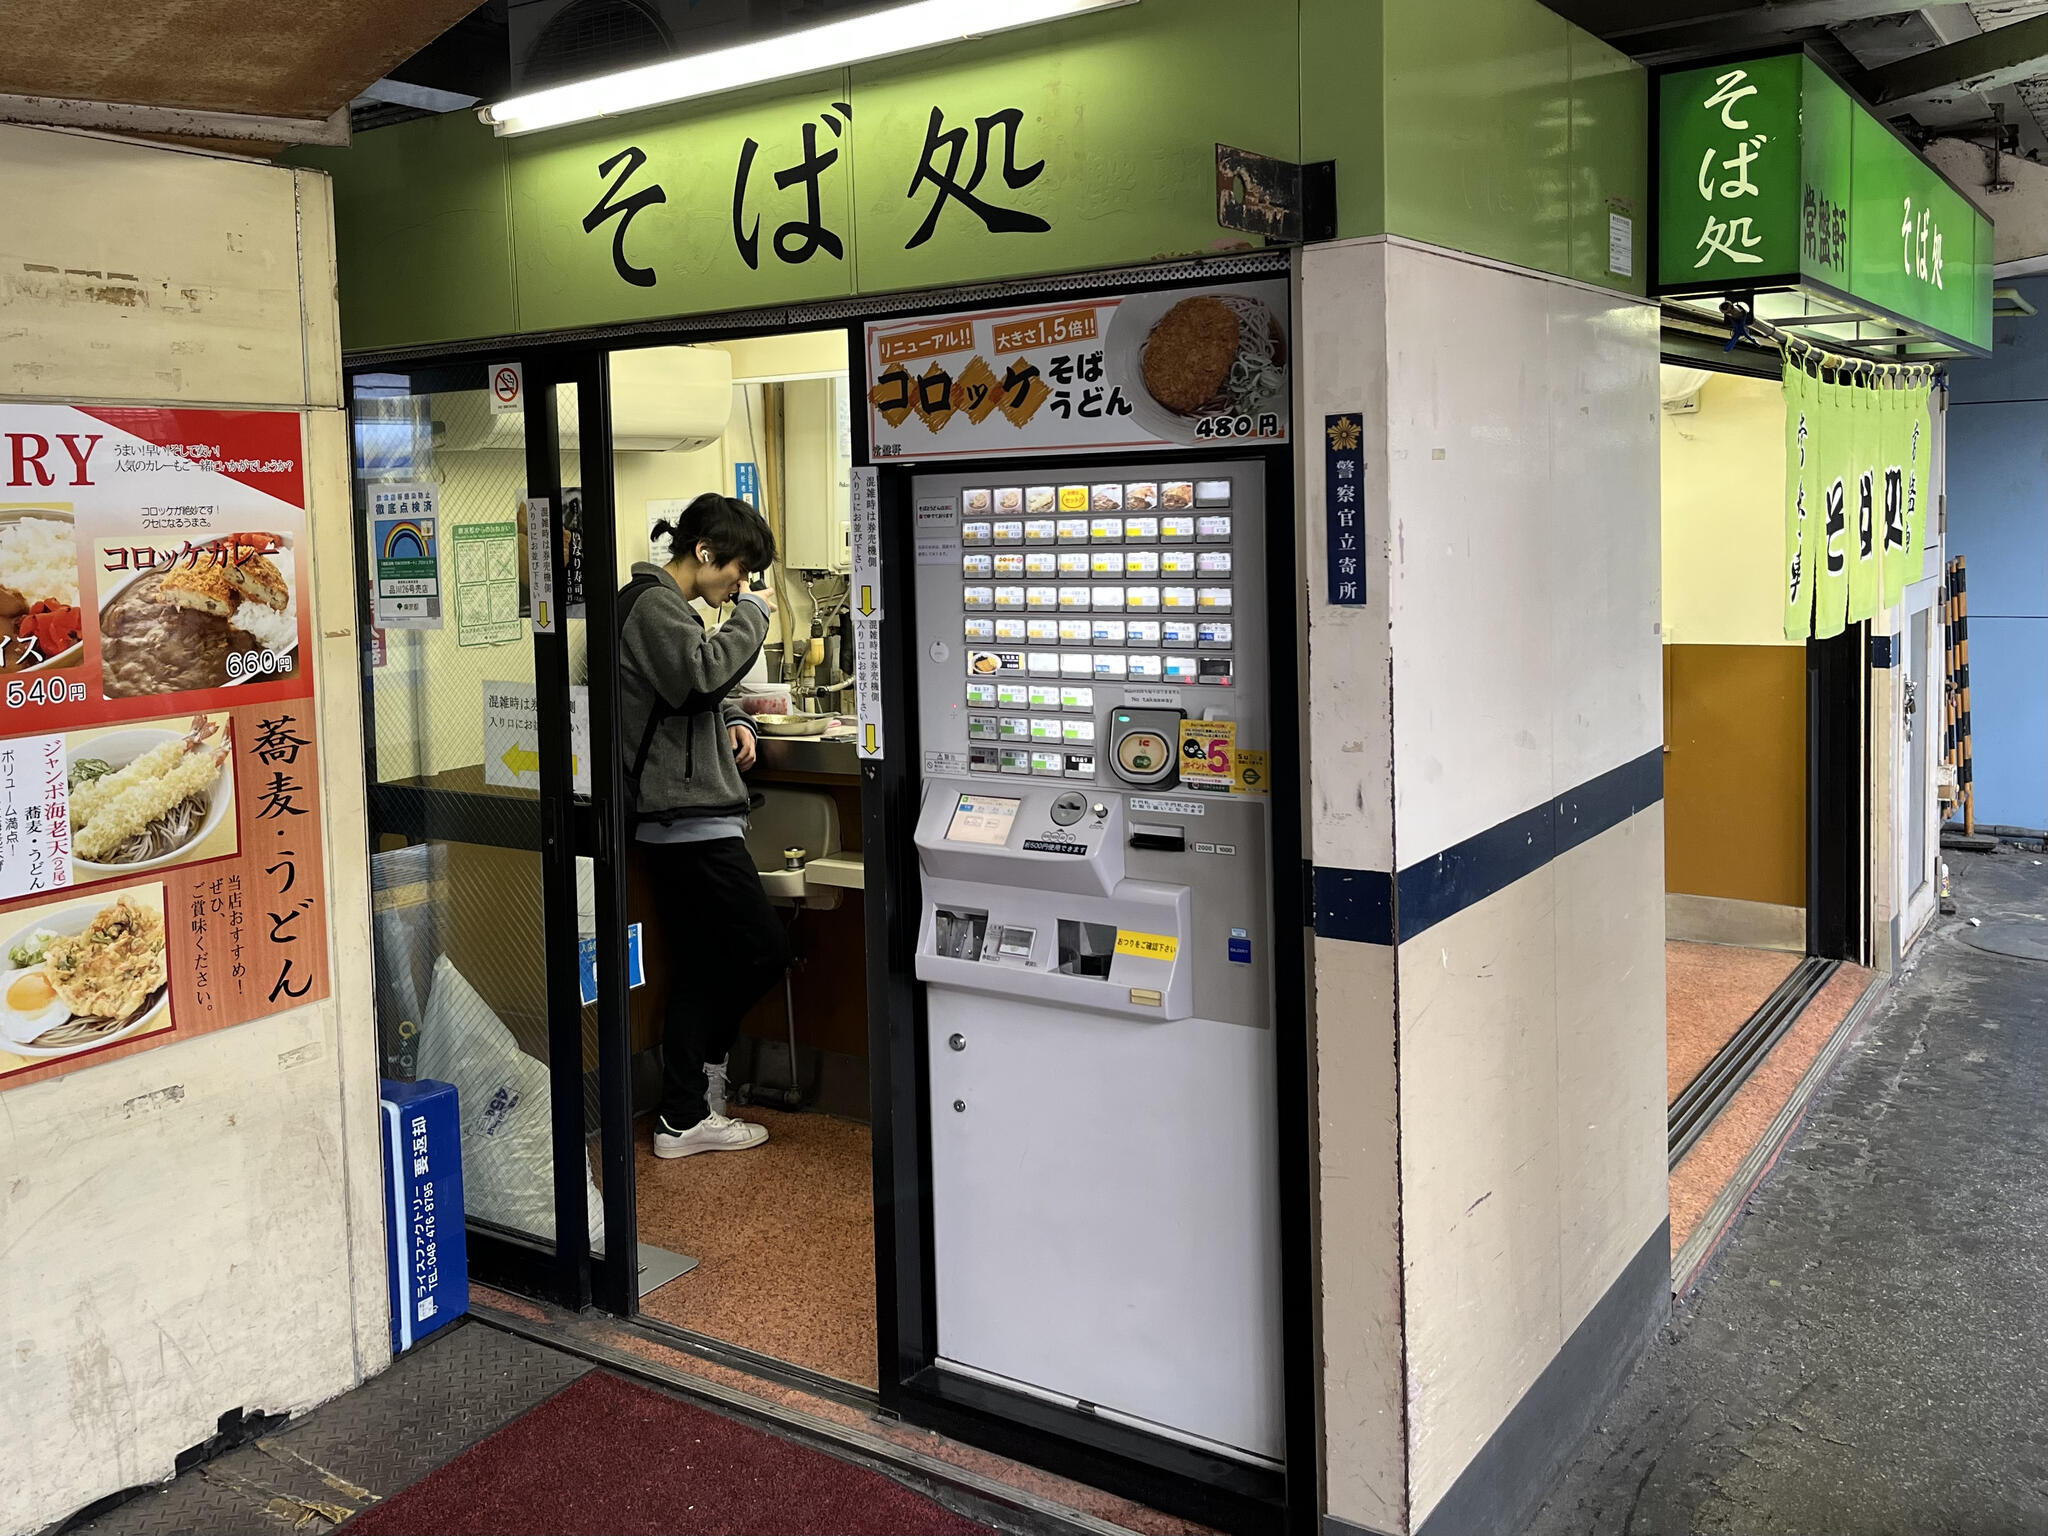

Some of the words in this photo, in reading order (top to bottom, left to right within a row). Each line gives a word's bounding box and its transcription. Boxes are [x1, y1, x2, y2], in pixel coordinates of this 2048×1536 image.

[1694, 70, 1767, 269] そば処
[583, 103, 1052, 287] そば処
[1902, 197, 1943, 290] そば処
[880, 325, 972, 358] リニューアル!!
[877, 364, 1040, 412] コロッケ
[1049, 350, 1105, 384] そば
[1050, 385, 1134, 419] うどん
[1195, 414, 1279, 440] 480円
[4, 433, 103, 486] RY
[142, 518, 212, 529] クセになるうまさ。
[1336, 459, 1358, 600] 警察官立寄所
[103, 540, 280, 572] コロッケカレー
[226, 651, 293, 678] 660円
[6, 677, 86, 709] 540円
[249, 715, 315, 1004] 蕎麦・うどん
[209, 877, 226, 918] ぜひ、
[191, 881, 213, 1011] ご賞味ください。
[228, 874, 247, 995] 当店おすすめ！
[1117, 937, 1177, 953] おつりをご確認下さい
[412, 1115, 430, 1178] 要返却
[413, 1186, 427, 1298] ライスファクトリー
